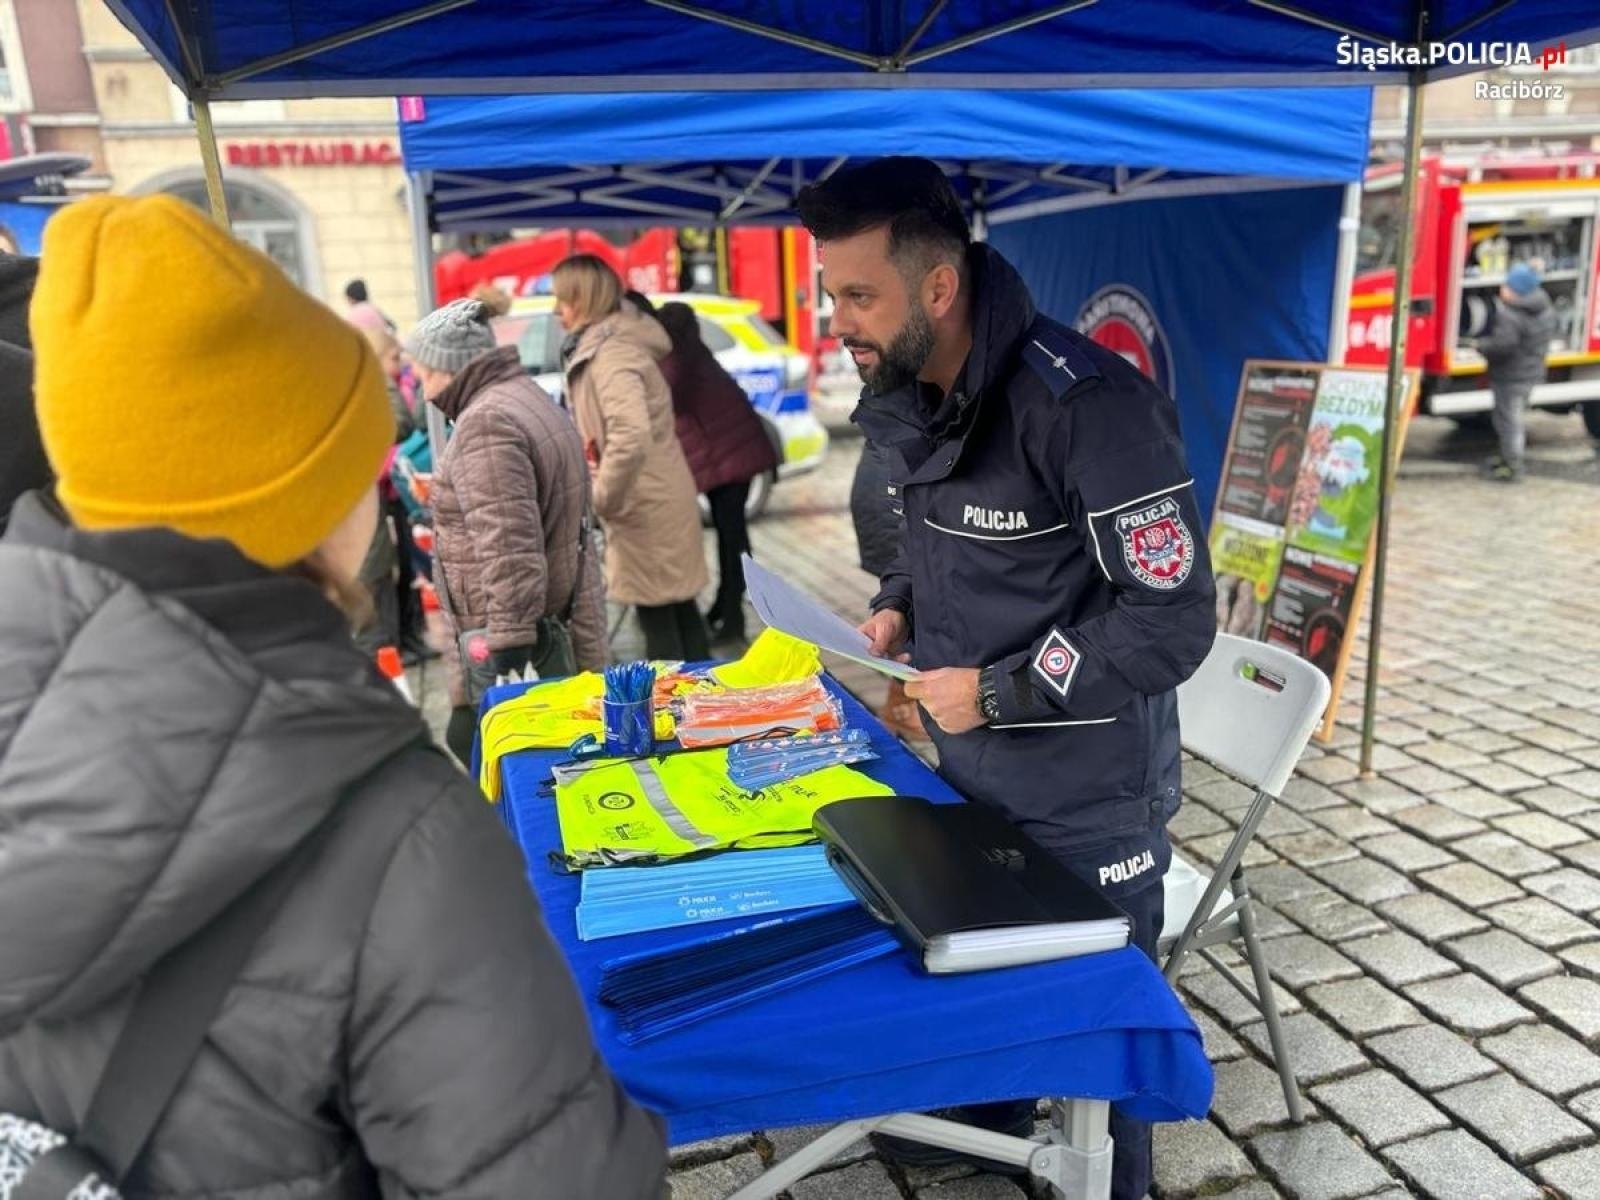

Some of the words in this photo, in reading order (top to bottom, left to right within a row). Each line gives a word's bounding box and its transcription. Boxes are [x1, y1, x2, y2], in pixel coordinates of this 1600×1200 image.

[963, 504, 1029, 531] POLICJA
[1119, 500, 1176, 529] POLICJA
[1098, 849, 1155, 886] POLICJA
